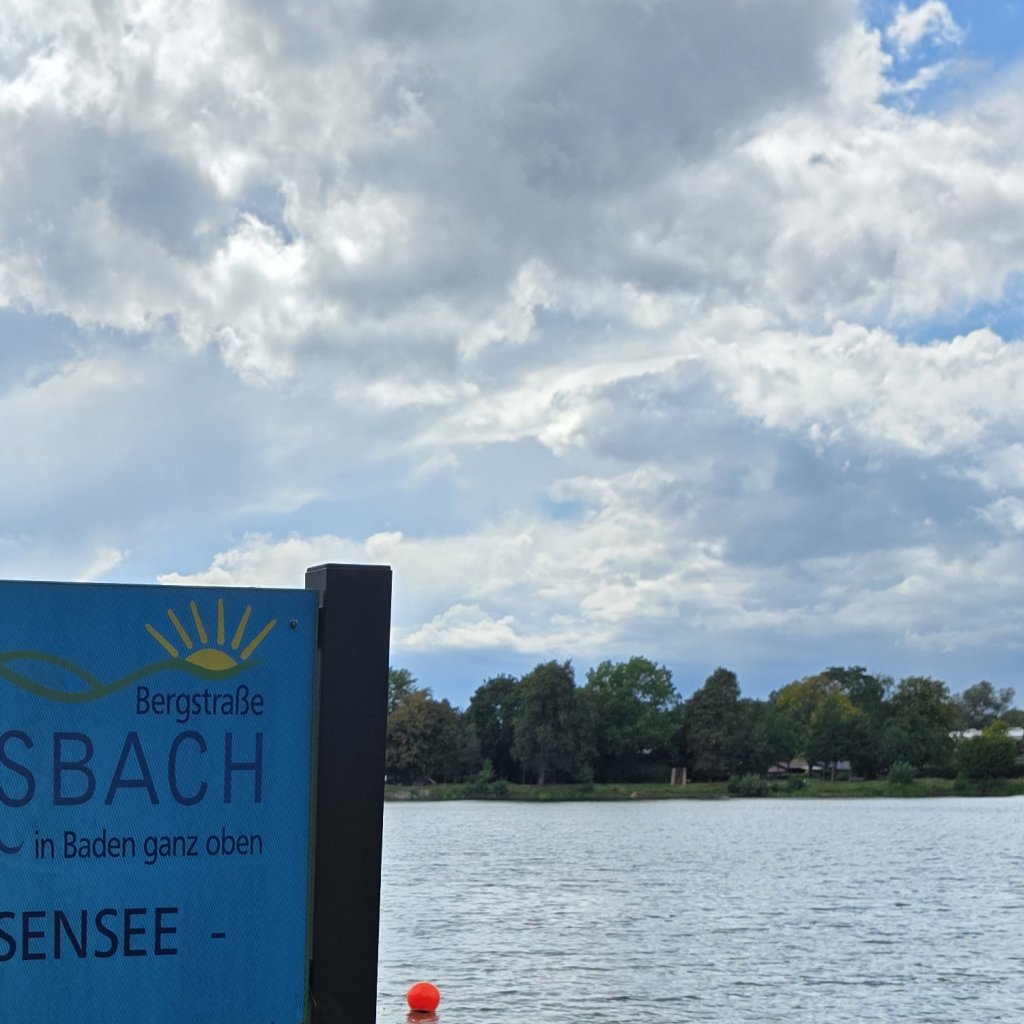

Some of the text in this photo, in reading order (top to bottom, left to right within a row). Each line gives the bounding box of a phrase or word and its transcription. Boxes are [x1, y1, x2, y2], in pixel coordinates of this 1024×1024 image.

[135, 685, 264, 724] Bergstraße
[34, 827, 263, 865] in Baden ganz oben
